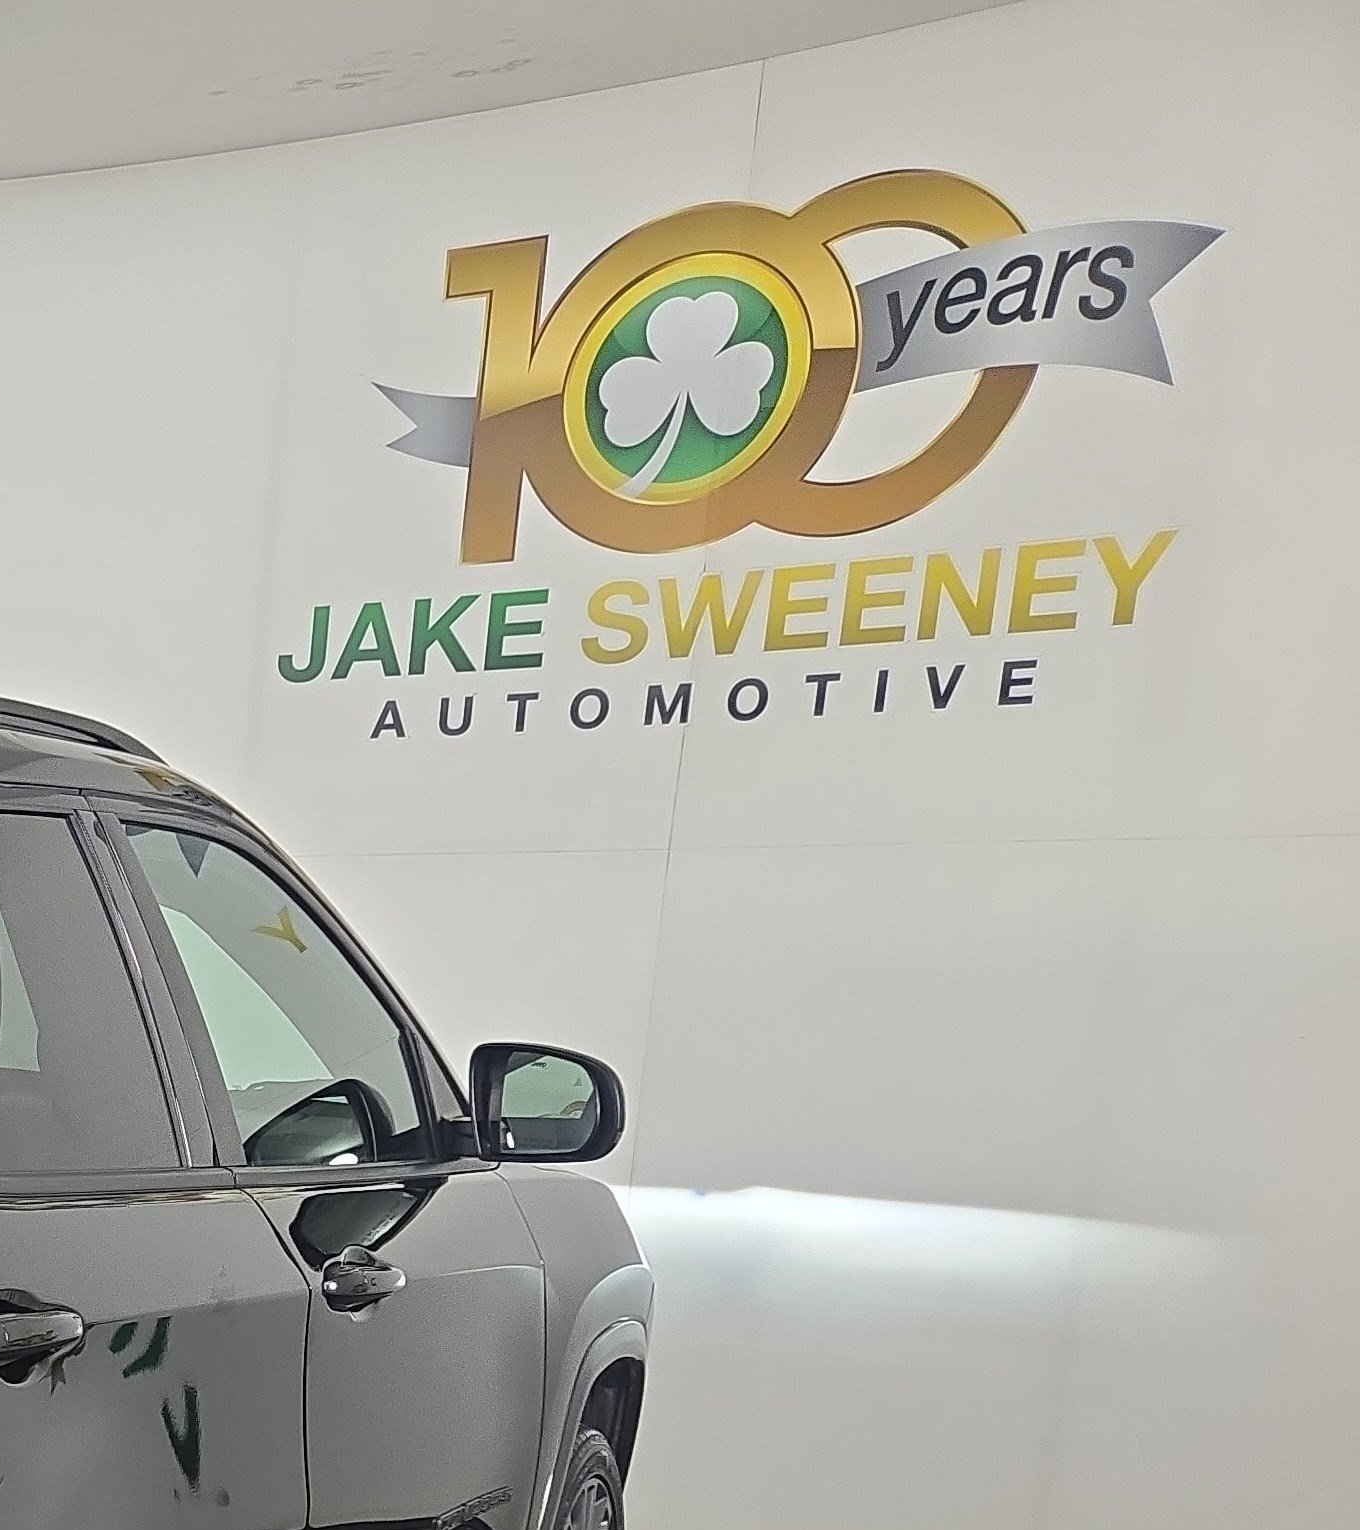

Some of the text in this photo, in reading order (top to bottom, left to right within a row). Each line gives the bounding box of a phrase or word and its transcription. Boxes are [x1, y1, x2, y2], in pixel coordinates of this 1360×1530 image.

[875, 241, 1137, 374] years
[277, 528, 1178, 685] JAKE SWEENEY
[370, 658, 1040, 740] AUTOMOTIVE
